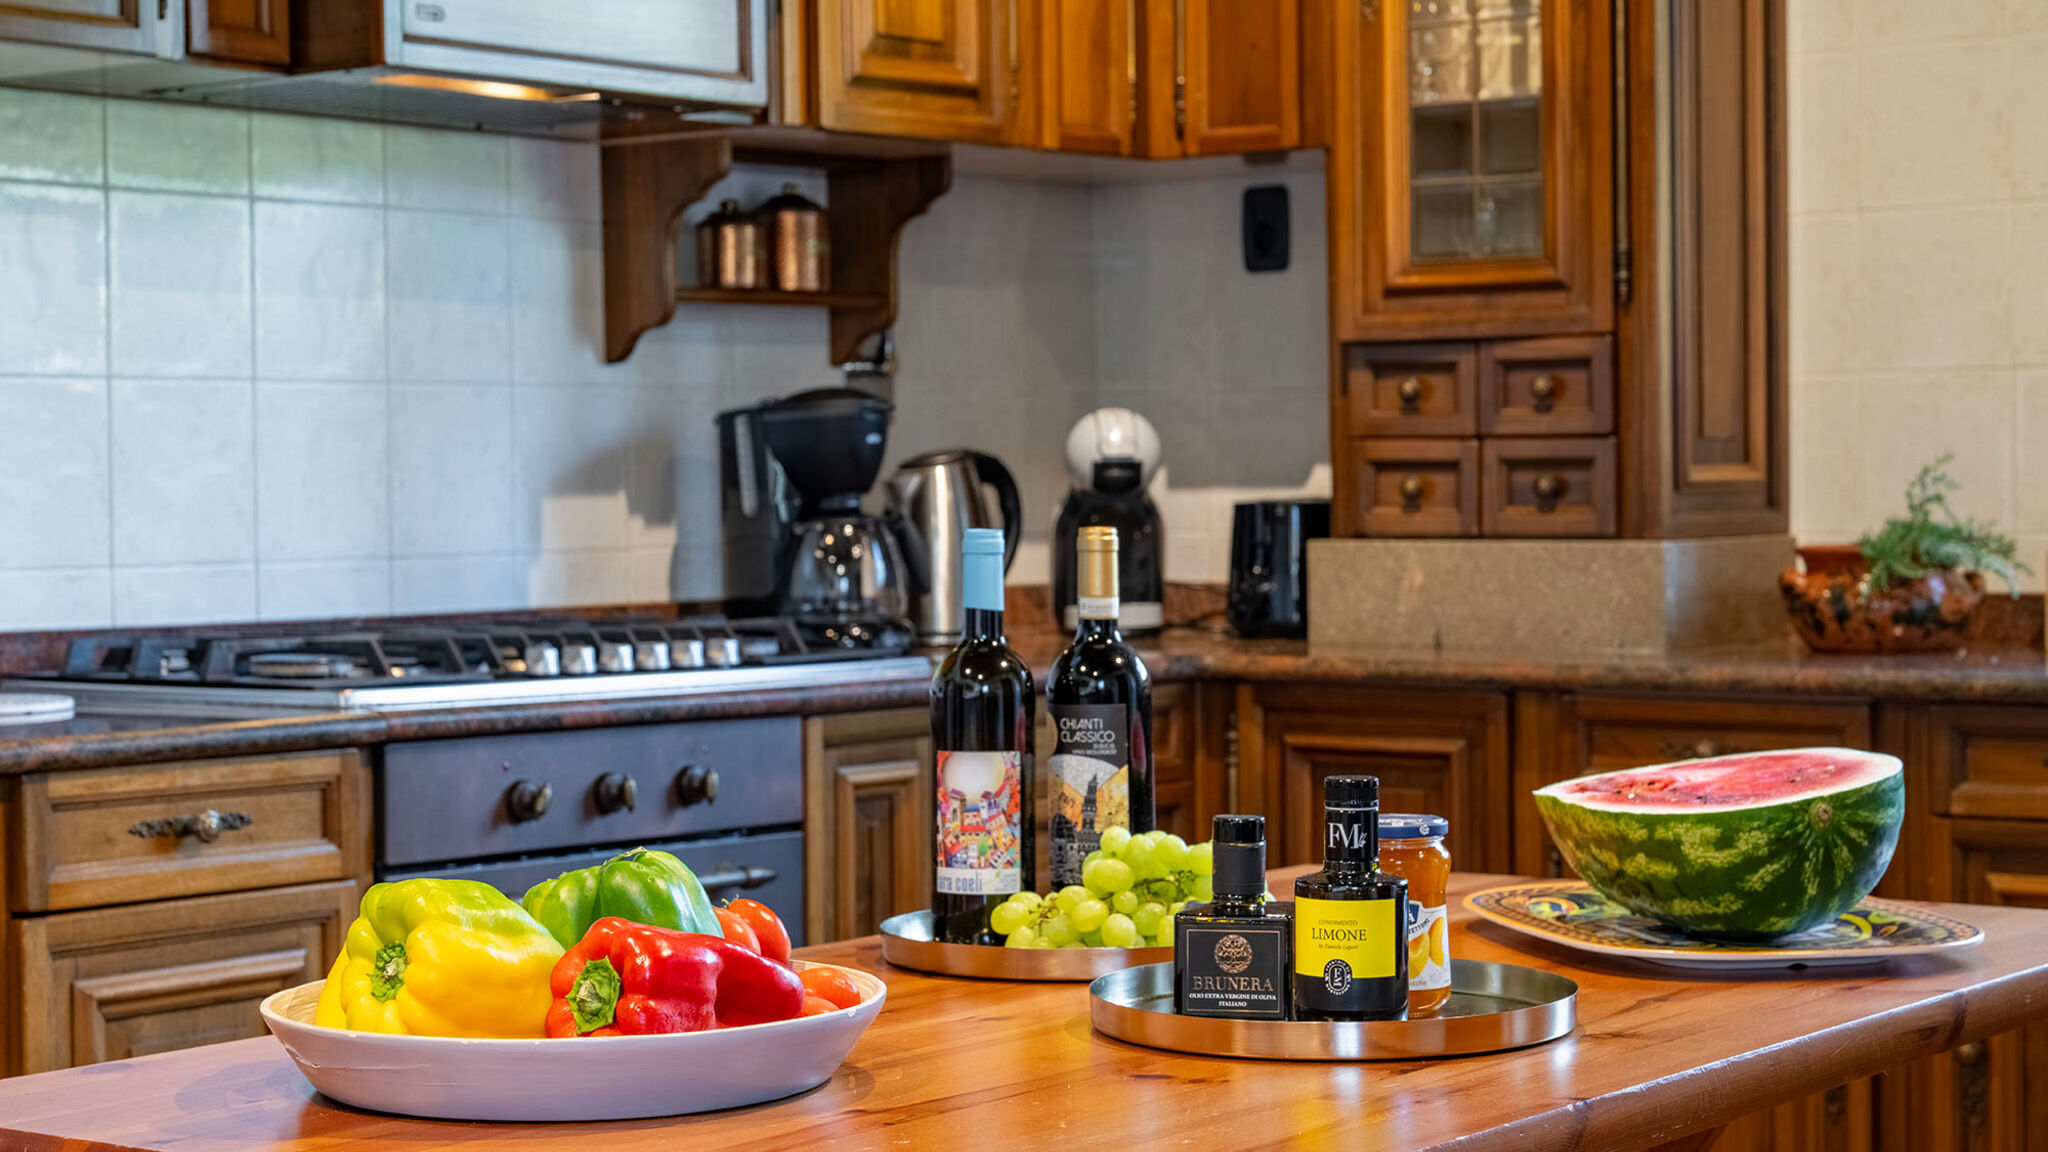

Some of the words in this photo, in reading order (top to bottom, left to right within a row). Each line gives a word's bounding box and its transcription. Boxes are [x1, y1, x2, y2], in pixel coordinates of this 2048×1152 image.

[1060, 717, 1103, 730] CHIANTI
[1060, 730, 1115, 743] CLASSICO
[955, 870, 982, 892] coeli
[1312, 927, 1367, 941] LIMONE
[1192, 976, 1274, 991] BRUNERA
